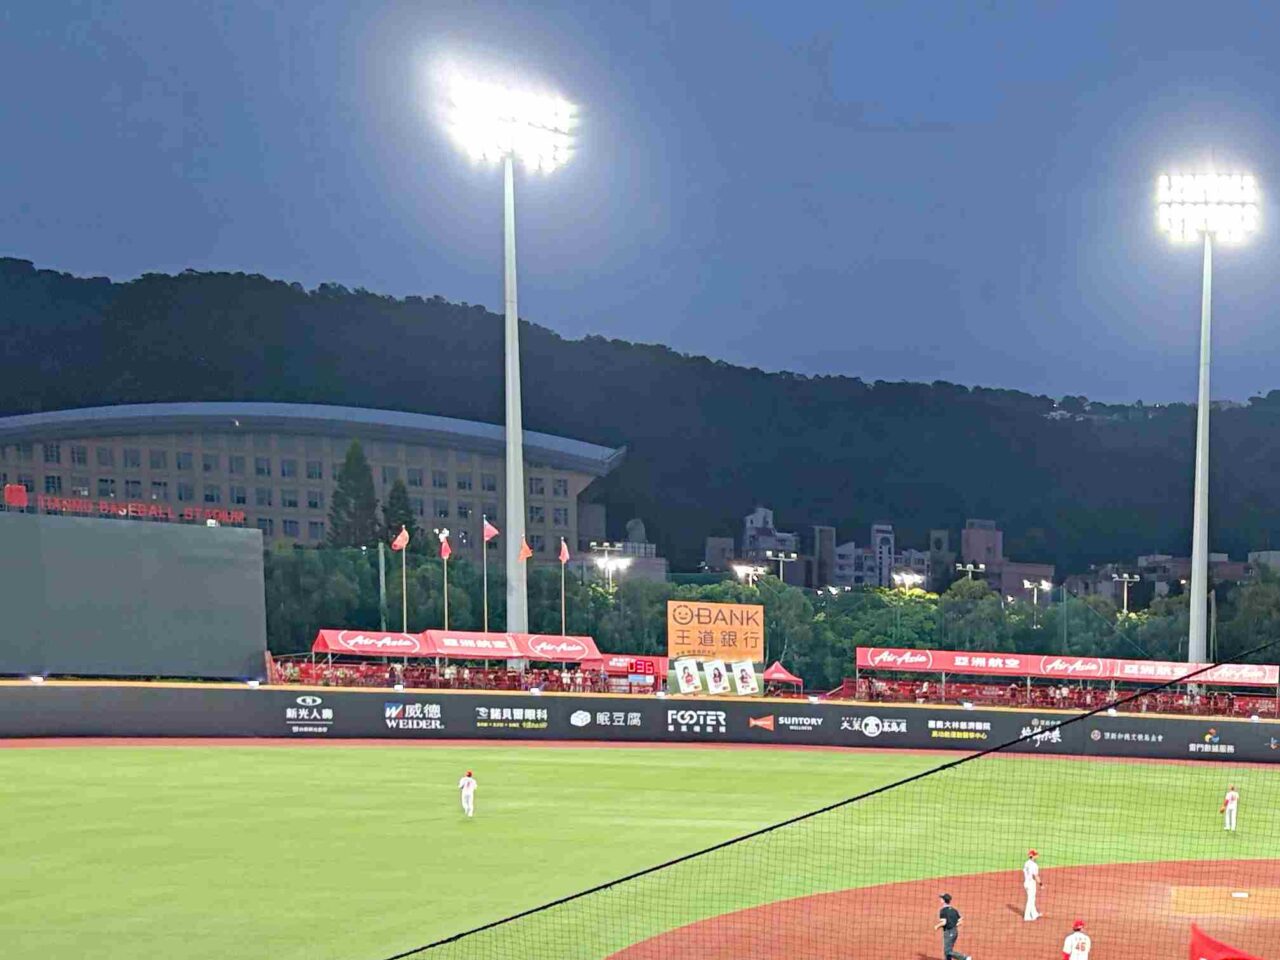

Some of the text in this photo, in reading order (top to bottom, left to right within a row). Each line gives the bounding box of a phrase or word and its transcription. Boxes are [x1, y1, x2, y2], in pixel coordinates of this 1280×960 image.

[99, 501, 175, 519] BASEBALL
[675, 629, 760, 649] 王道銀行
[953, 656, 1020, 669] 亞洲航空
[286, 708, 333, 720] 新光人壽
[405, 704, 441, 719] 威德
[490, 708, 548, 720] 諾貝爾眼科
[667, 710, 726, 725] FOOTER
[385, 719, 442, 730] WEIDER
[597, 712, 642, 726] 眠豆腐
[778, 716, 823, 726] SUNTORY
